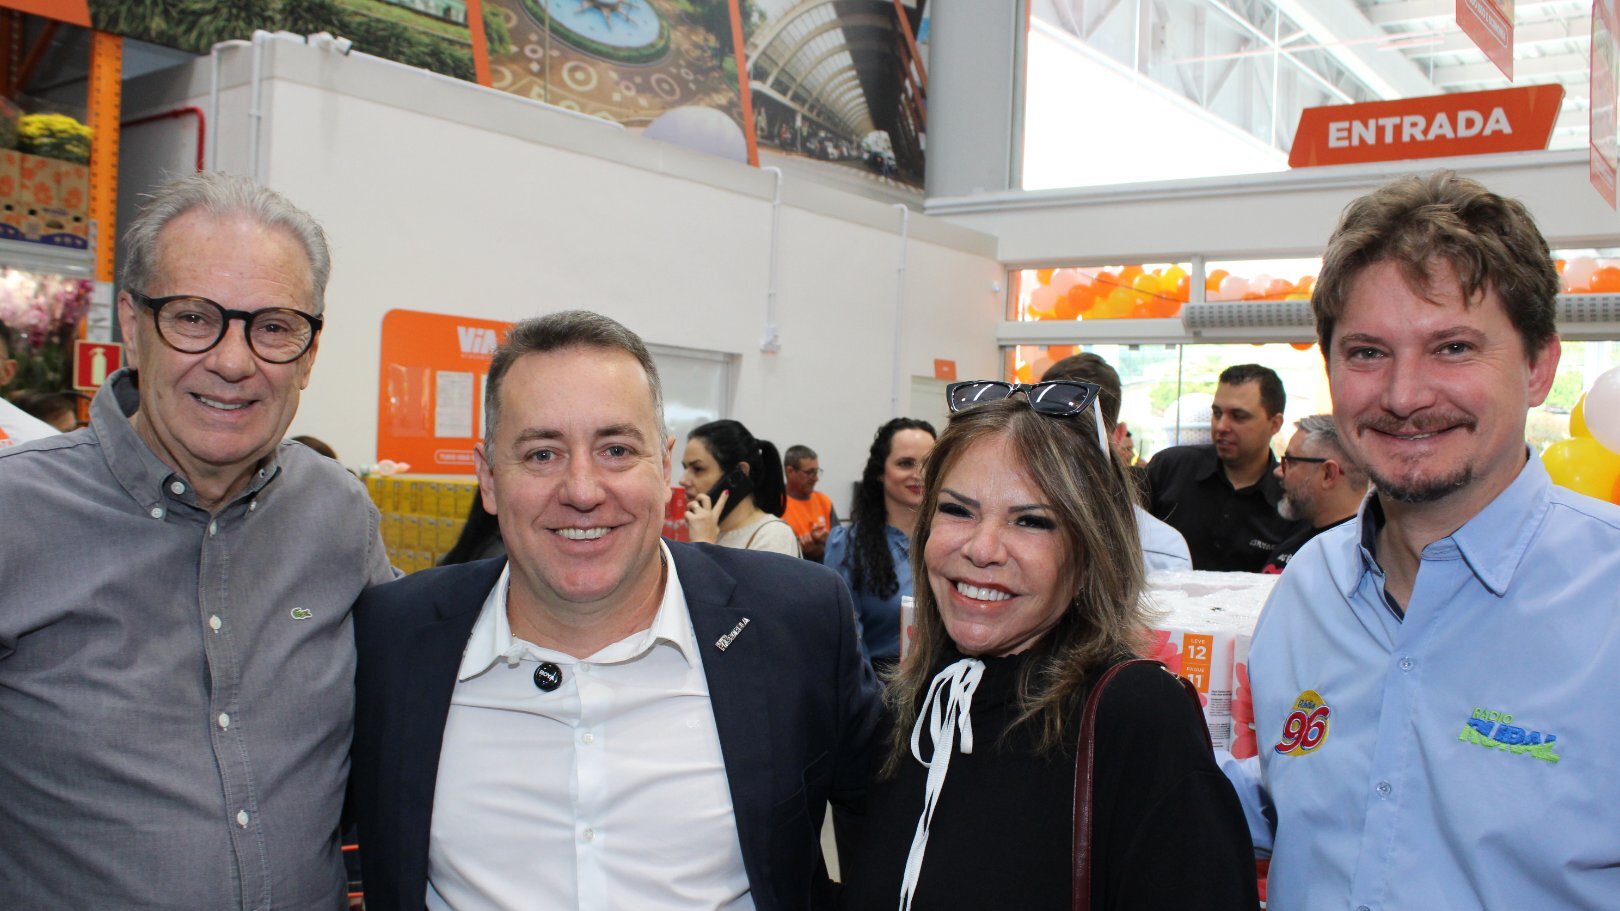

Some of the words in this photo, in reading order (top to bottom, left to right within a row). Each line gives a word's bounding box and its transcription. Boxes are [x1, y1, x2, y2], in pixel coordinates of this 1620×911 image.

[1328, 107, 1513, 148] ENTRADA
[1188, 645, 1207, 660] 12
[1275, 705, 1331, 755] 96
[1458, 718, 1560, 763] RURAL
